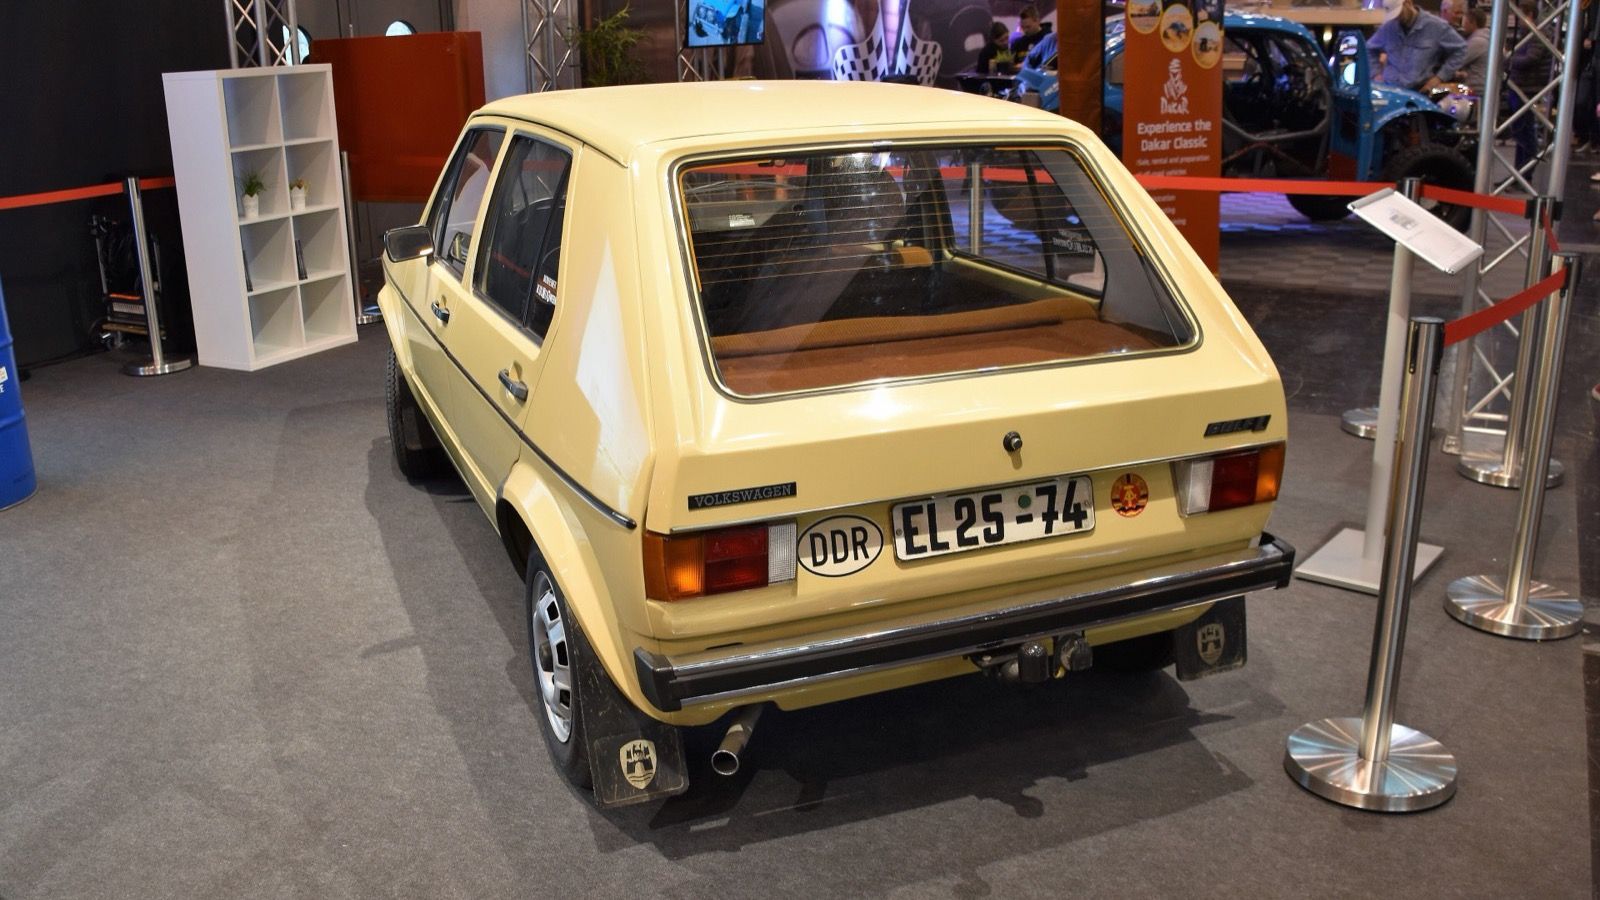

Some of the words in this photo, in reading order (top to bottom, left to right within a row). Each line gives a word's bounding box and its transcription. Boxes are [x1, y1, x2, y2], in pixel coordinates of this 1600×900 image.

[1137, 120, 1193, 136] Experience
[1195, 119, 1212, 131] the
[1141, 138, 1171, 152] Dakar
[1173, 136, 1208, 150] Classic
[694, 485, 792, 507] VOLKSWAGEN
[809, 526, 870, 567] DDR
